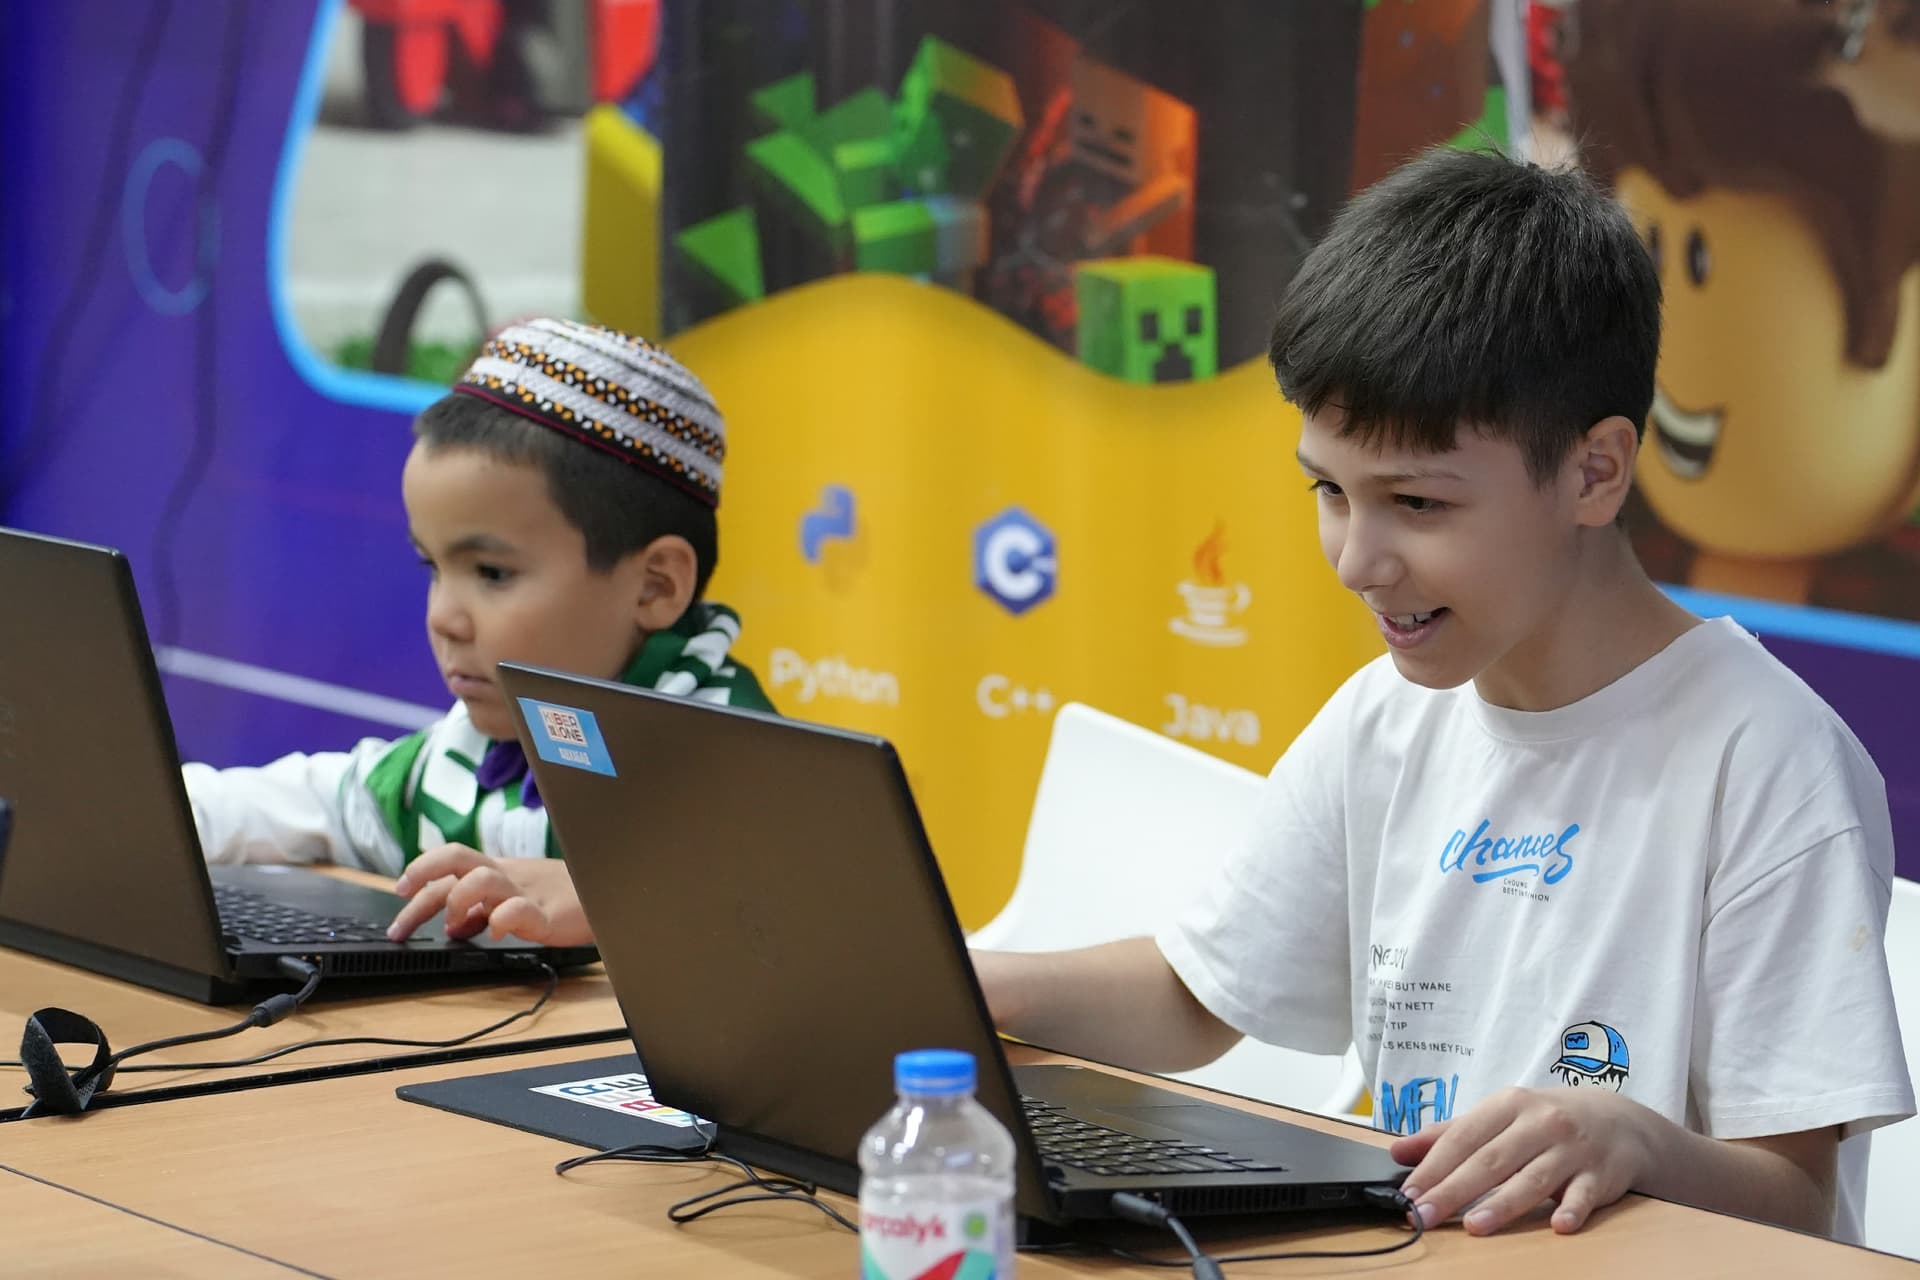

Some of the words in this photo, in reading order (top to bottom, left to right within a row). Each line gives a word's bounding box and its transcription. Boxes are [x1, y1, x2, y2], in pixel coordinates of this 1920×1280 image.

[769, 647, 899, 705] Python
[976, 674, 1054, 718] C++
[1163, 693, 1260, 745] Java
[1395, 982, 1416, 992] BUT
[1420, 982, 1452, 992] WANE
[1405, 1002, 1434, 1011] NETT
[1390, 1022, 1408, 1031] TIP
[1397, 1041, 1427, 1051] KENS
